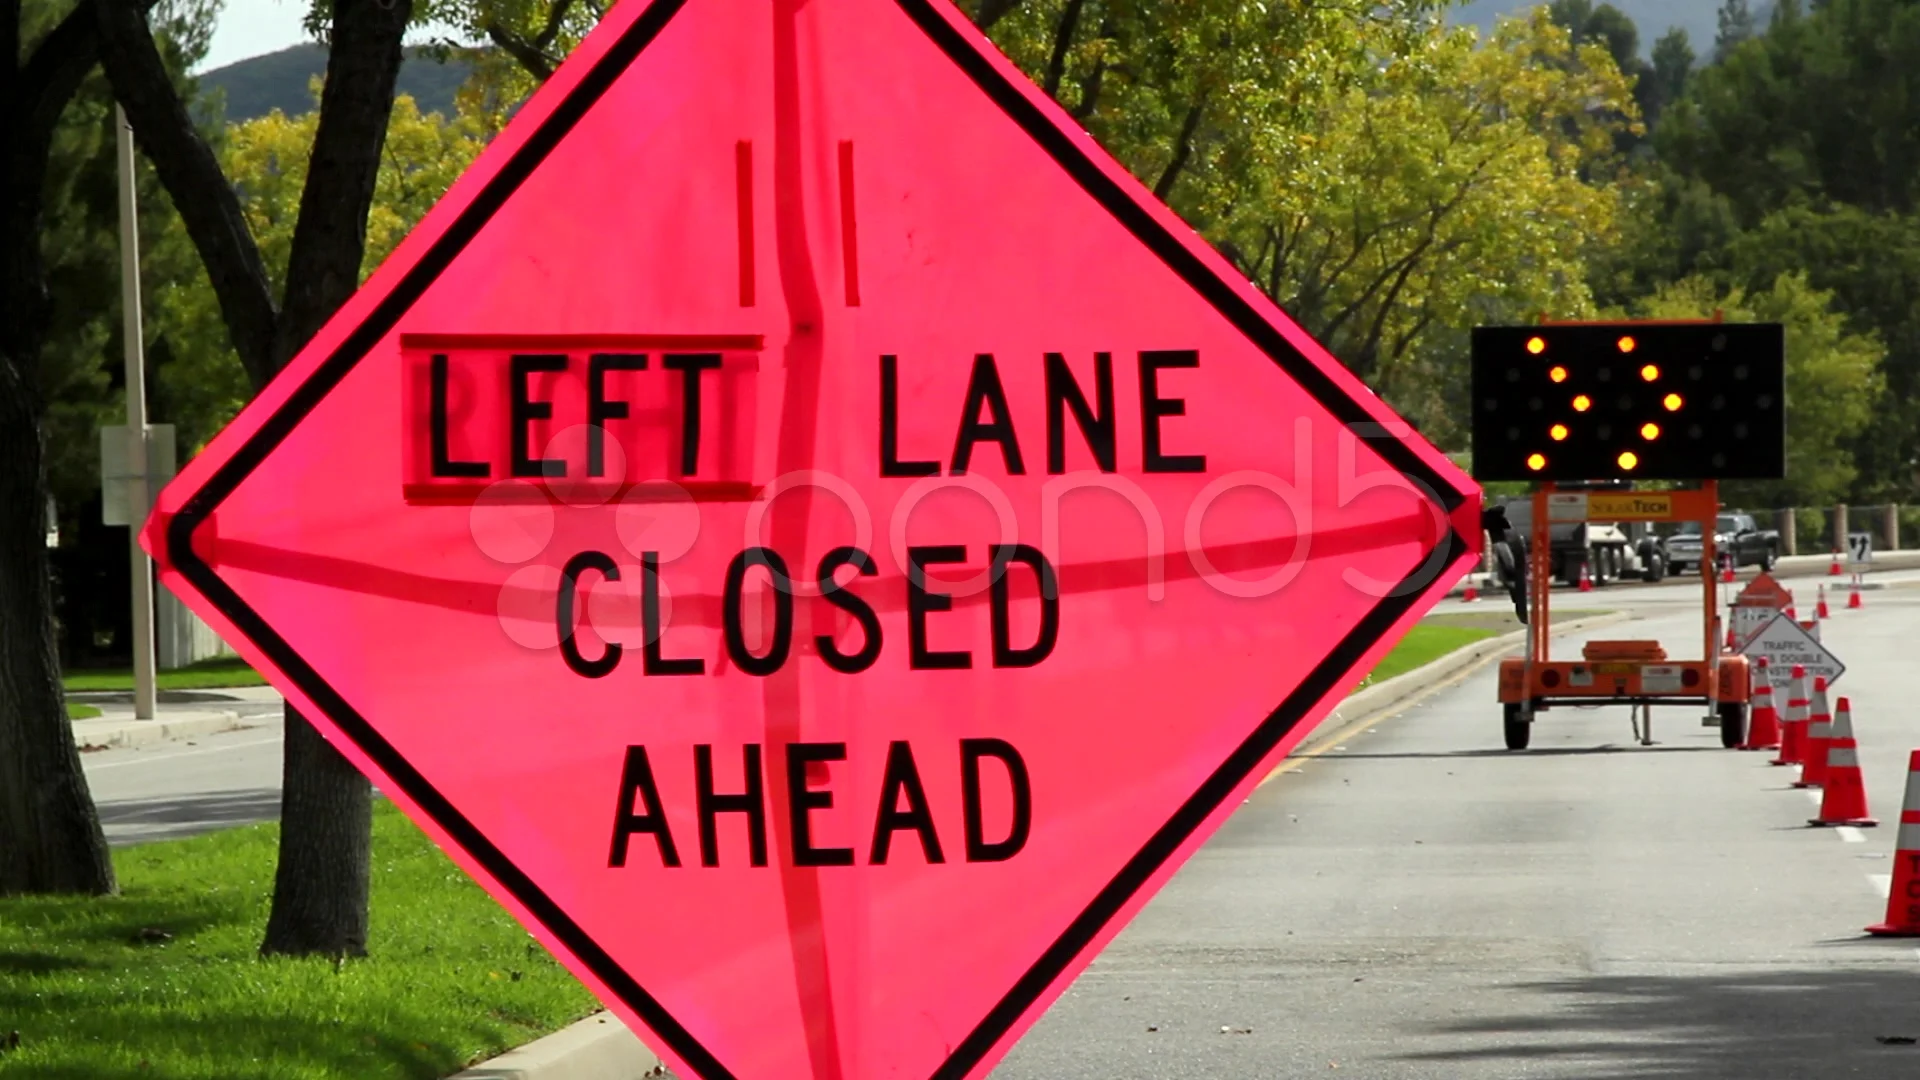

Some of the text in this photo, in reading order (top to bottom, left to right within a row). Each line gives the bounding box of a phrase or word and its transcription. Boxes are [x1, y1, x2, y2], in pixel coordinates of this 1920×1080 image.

[430, 351, 1205, 478] LEFT LANE
[558, 544, 1058, 679] CLOSED
[1763, 641, 1804, 651] TRAFFIC
[611, 738, 1030, 867] AHEAD
